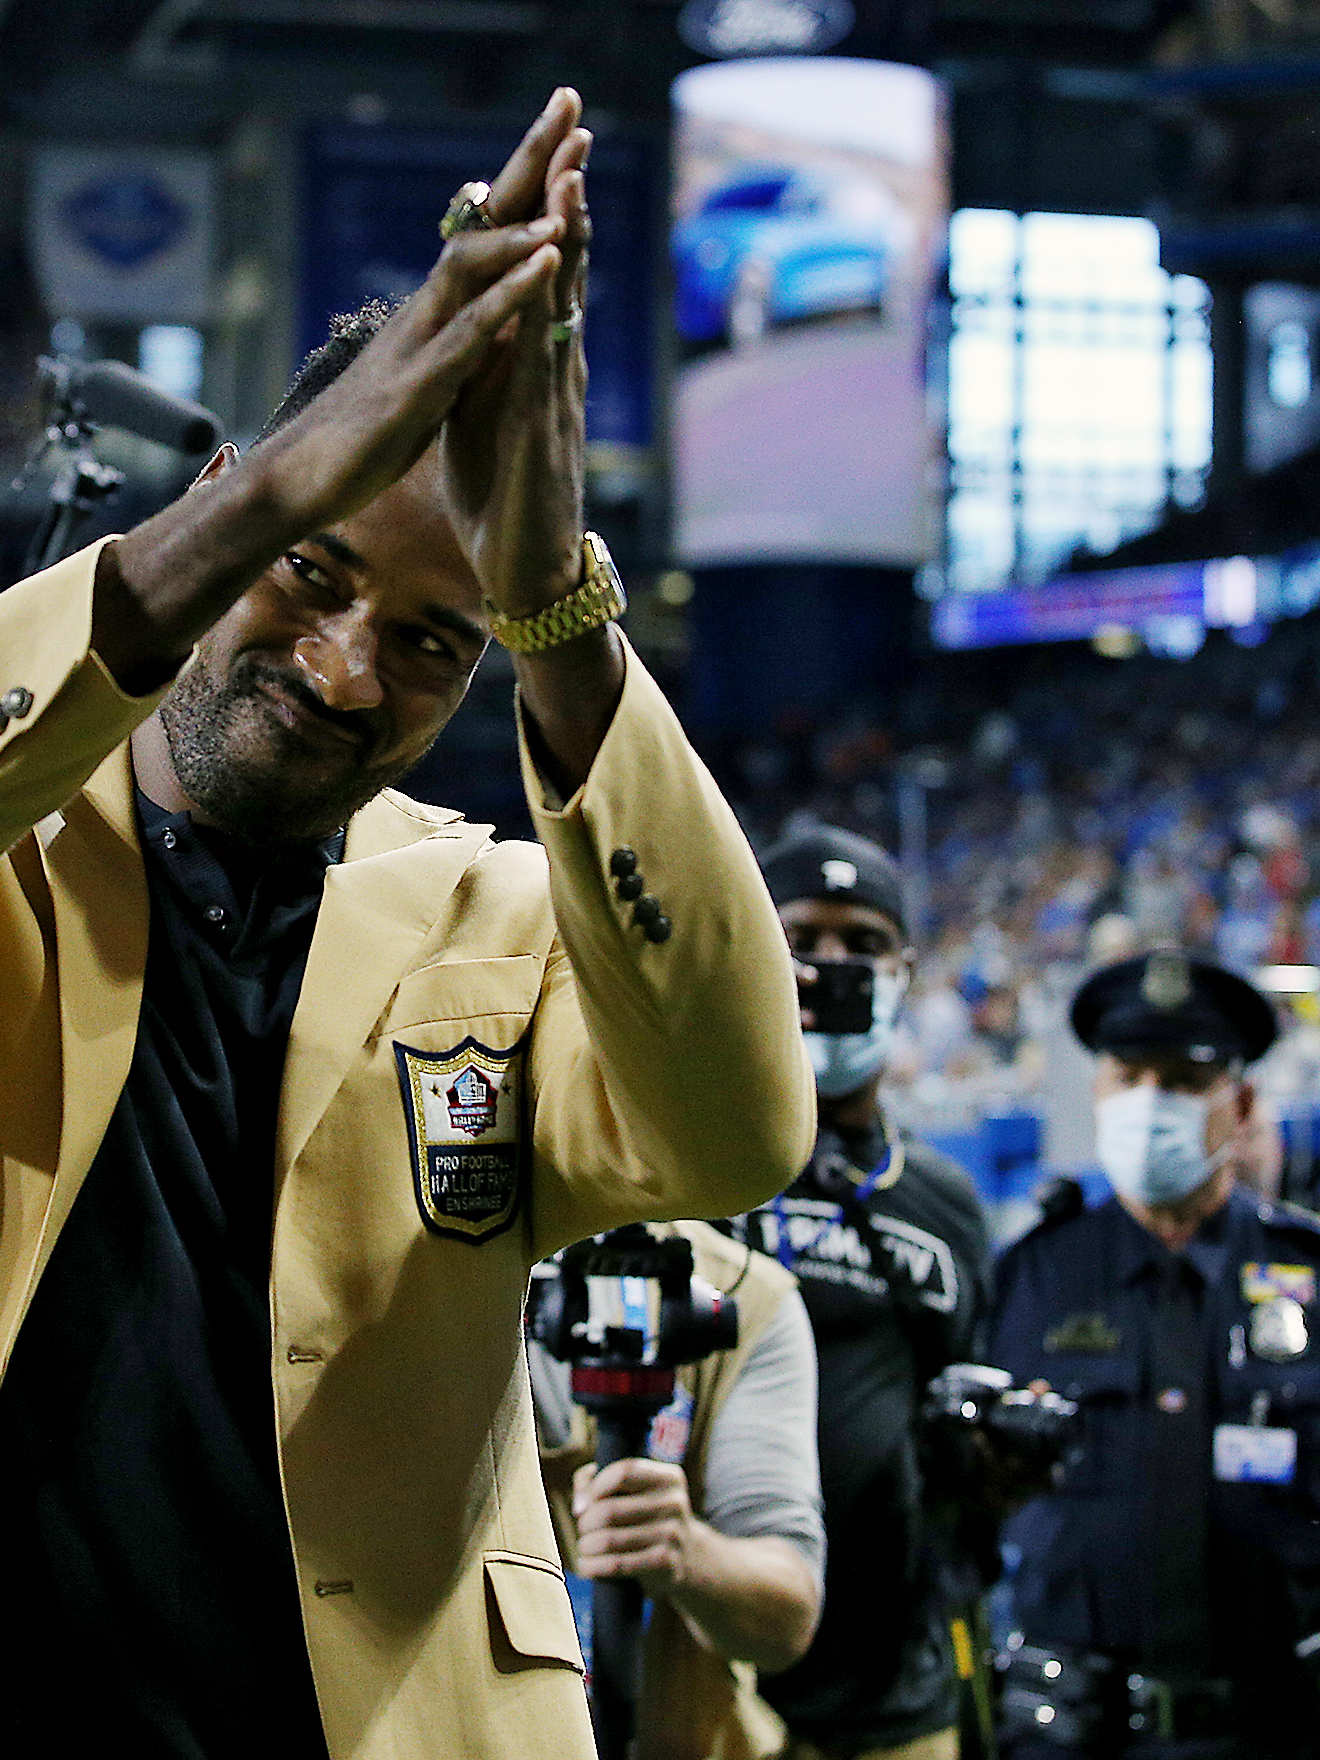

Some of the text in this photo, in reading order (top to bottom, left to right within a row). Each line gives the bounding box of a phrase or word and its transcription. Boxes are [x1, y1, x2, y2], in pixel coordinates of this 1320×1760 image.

[435, 1155, 510, 1171] PRO FOOTBALL
[431, 1174, 468, 1194] HALL
[469, 1173, 486, 1192] OF
[446, 1194, 502, 1212] ENSHREE
